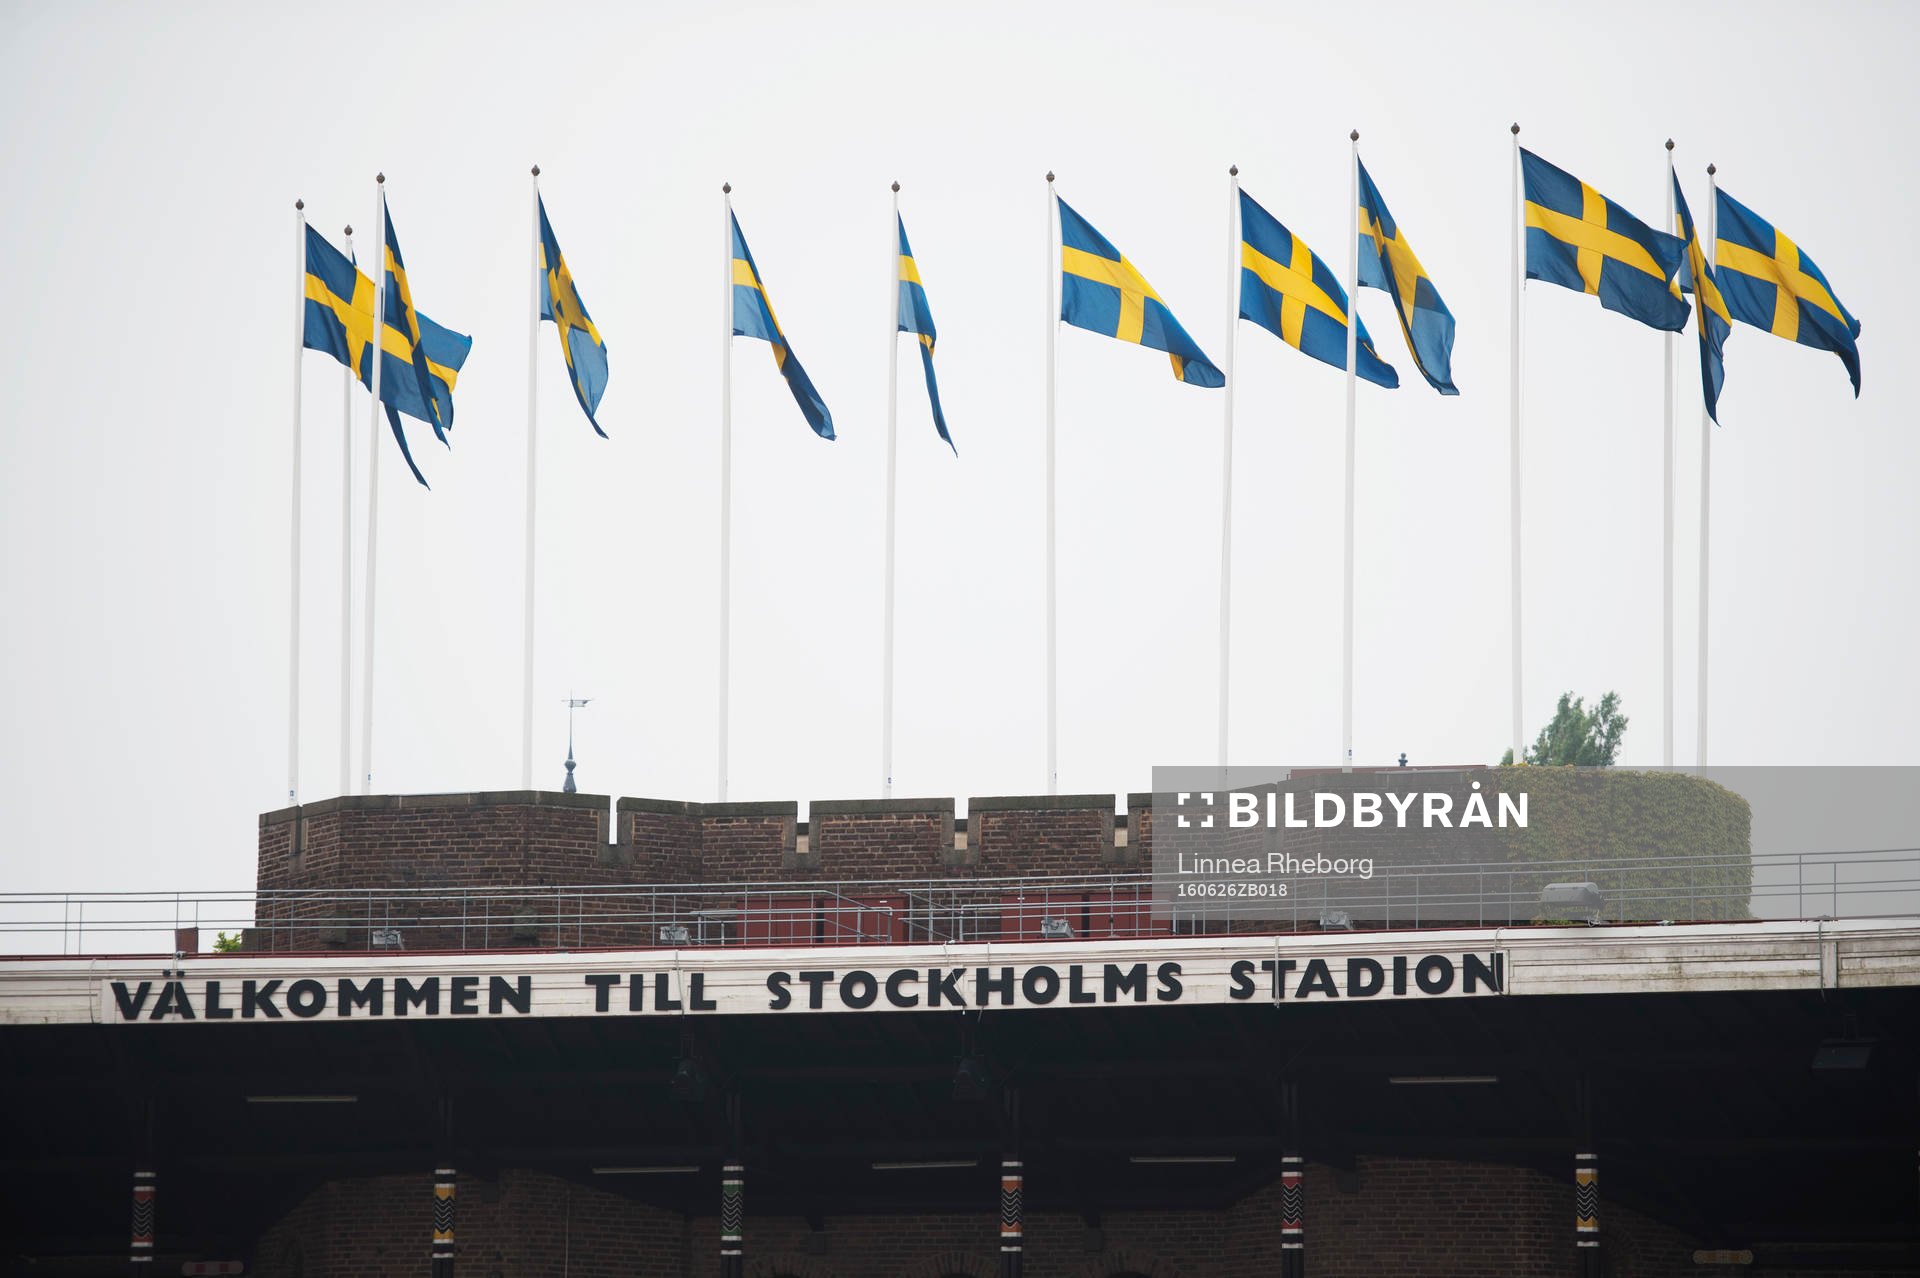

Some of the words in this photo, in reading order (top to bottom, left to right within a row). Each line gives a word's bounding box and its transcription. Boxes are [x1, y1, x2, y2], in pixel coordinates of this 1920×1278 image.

[111, 970, 532, 1020] VÄLKOMMEN
[585, 973, 717, 1012] TILL
[767, 962, 1184, 1010] STOCKHOLMS
[1230, 953, 1504, 1000] STADION
